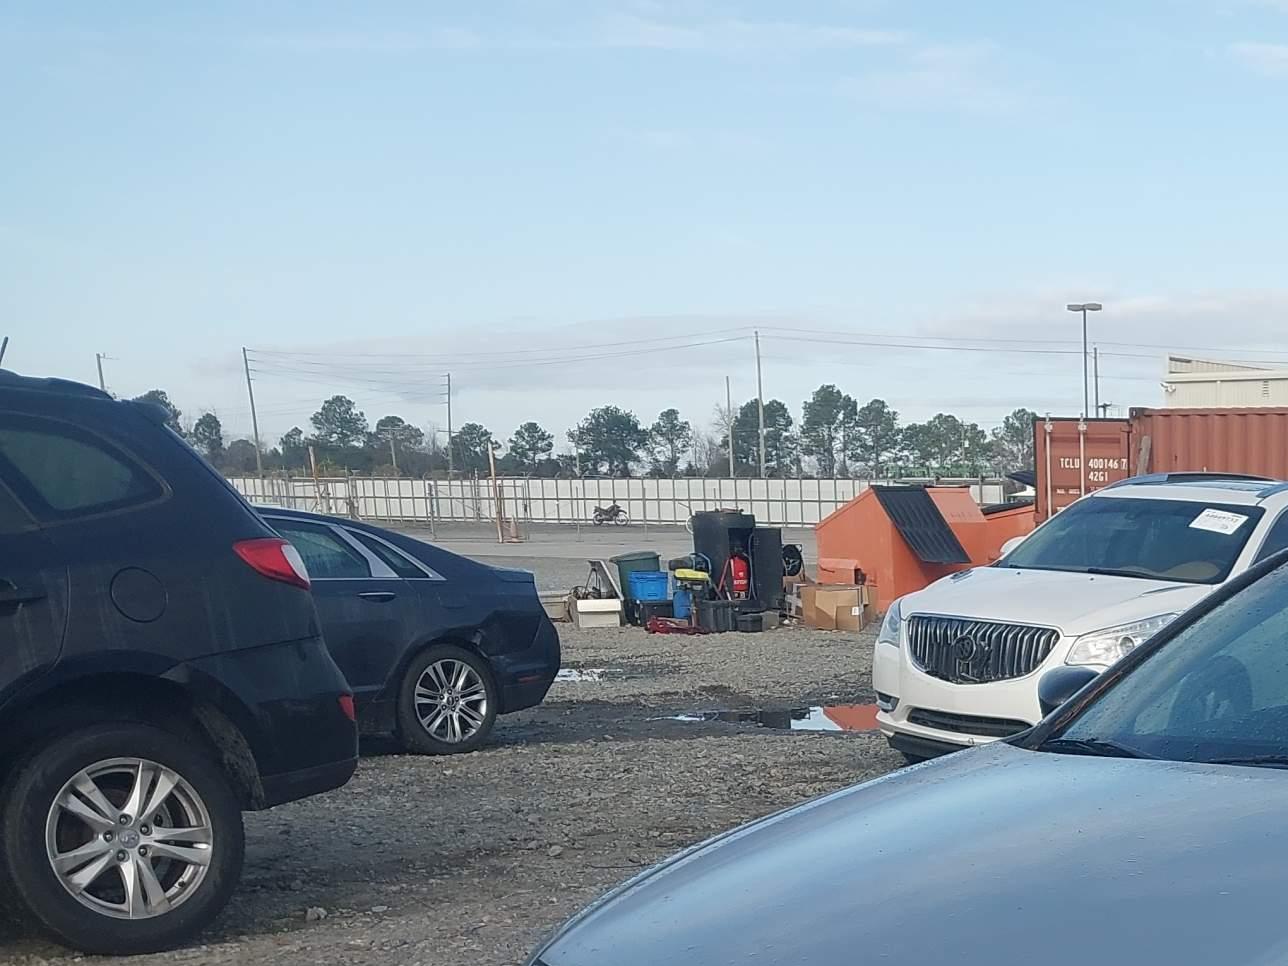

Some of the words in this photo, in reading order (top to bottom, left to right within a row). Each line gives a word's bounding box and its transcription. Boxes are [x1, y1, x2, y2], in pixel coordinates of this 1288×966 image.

[1060, 457, 1080, 469] TCLU
[1088, 458, 1119, 470] 400146
[1088, 471, 1109, 482] 42G1
